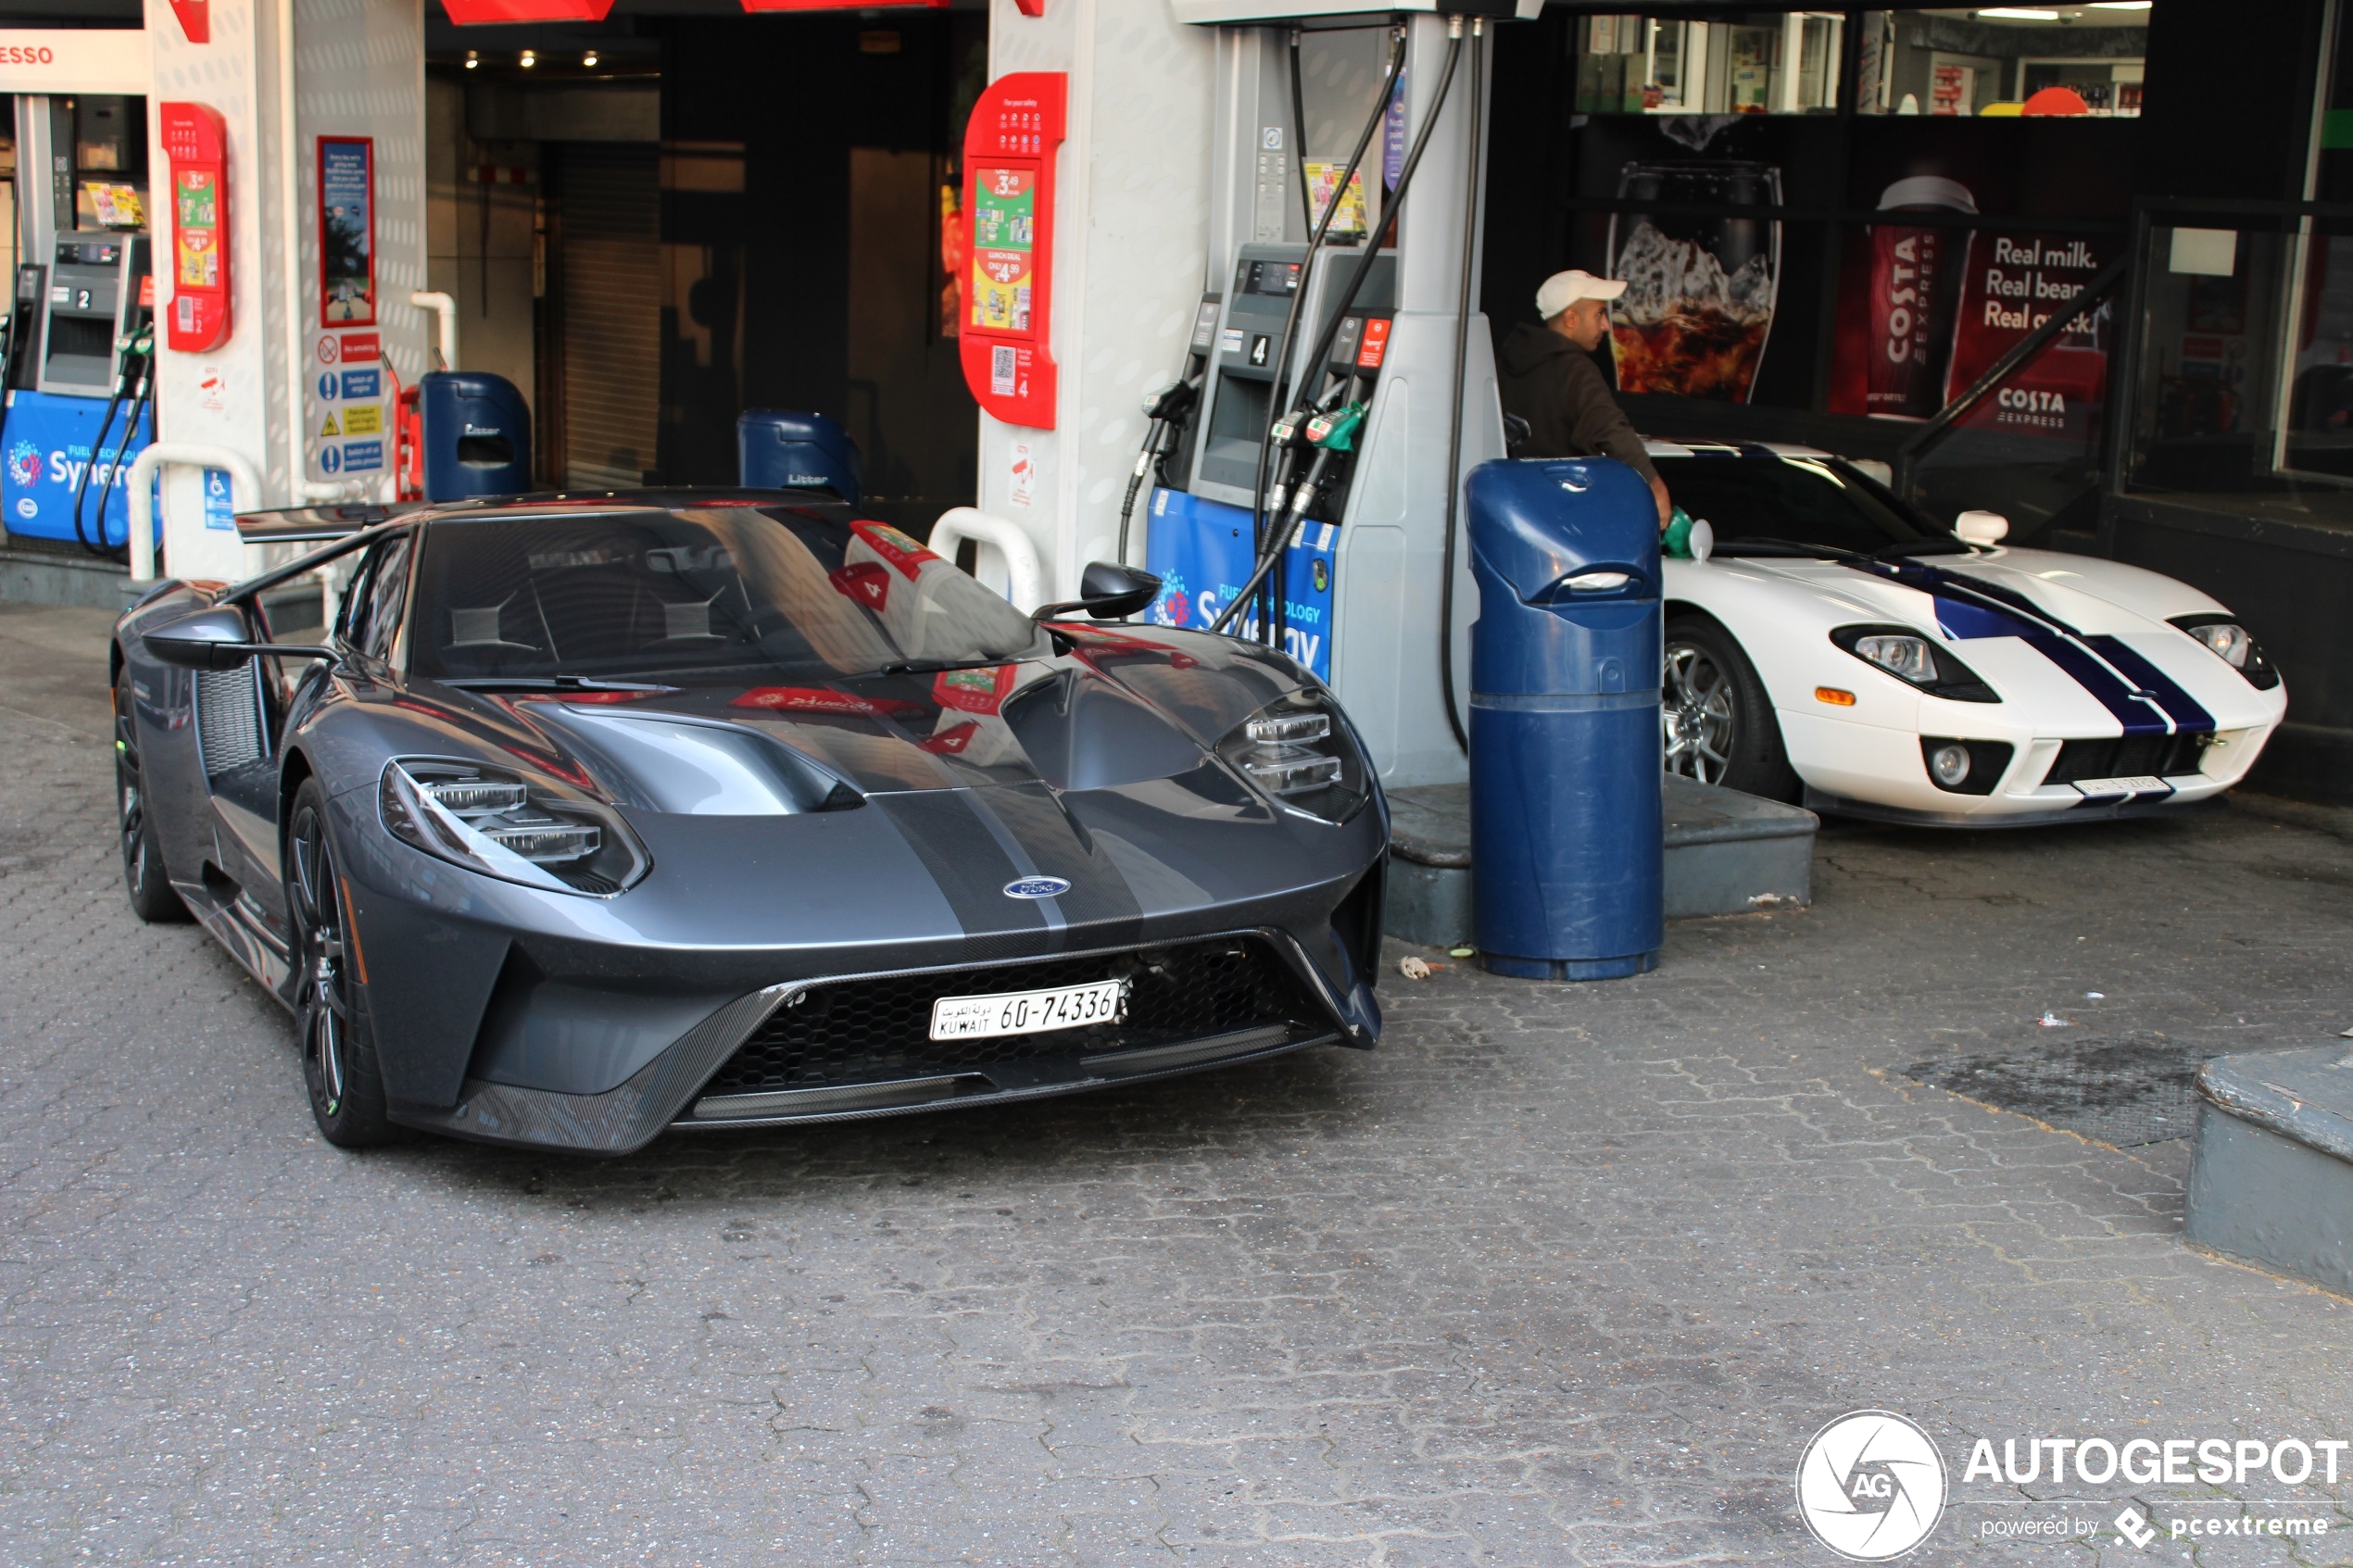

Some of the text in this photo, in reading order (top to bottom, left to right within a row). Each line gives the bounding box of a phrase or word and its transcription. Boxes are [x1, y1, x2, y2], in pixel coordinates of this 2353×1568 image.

[988, 251, 1022, 261] LUNCH DEAL
[1995, 237, 2097, 269] Real milk.
[1915, 234, 1934, 343] EXPRESS
[1986, 269, 2031, 296] Real
[78, 290, 90, 308] 2
[1888, 236, 1916, 363] COSTA
[1984, 300, 2030, 329] Real
[195, 319, 202, 333] 2
[1253, 337, 1266, 364] 4
[1018, 380, 1028, 397] 4
[1998, 387, 2065, 414] COSTA
[2007, 413, 2065, 428] EXPRESS
[69, 445, 91, 457] FUEL
[788, 474, 829, 484] Litter
[1020, 880, 1056, 894] Ford
[942, 1003, 991, 1020] دولة الكويت
[1000, 987, 1113, 1029] 60-74336
[939, 1018, 990, 1035] KUWAIT
